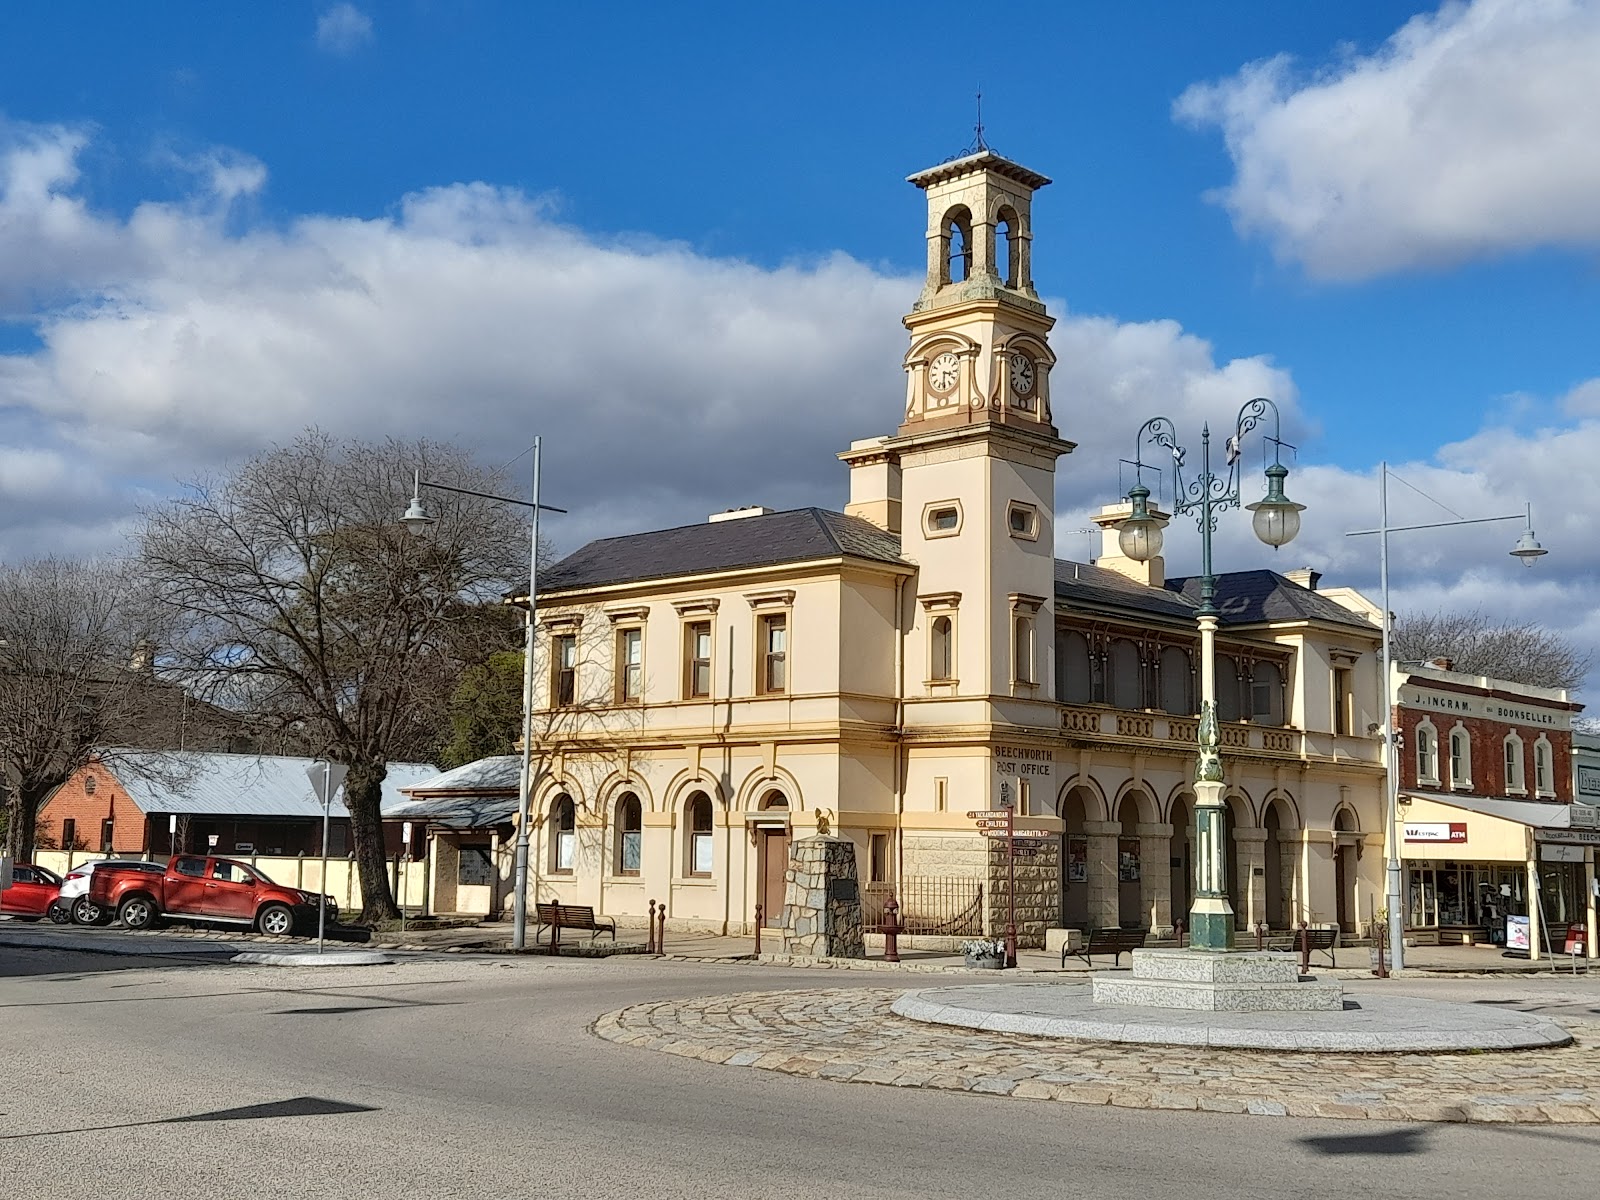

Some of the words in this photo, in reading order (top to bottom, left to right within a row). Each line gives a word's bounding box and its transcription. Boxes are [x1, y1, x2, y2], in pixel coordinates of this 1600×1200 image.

[995, 745, 1052, 761] BEECHWORTH
[996, 761, 1016, 773] POST
[1021, 763, 1050, 776] OFFICE
[1450, 831, 1465, 839] ATM
